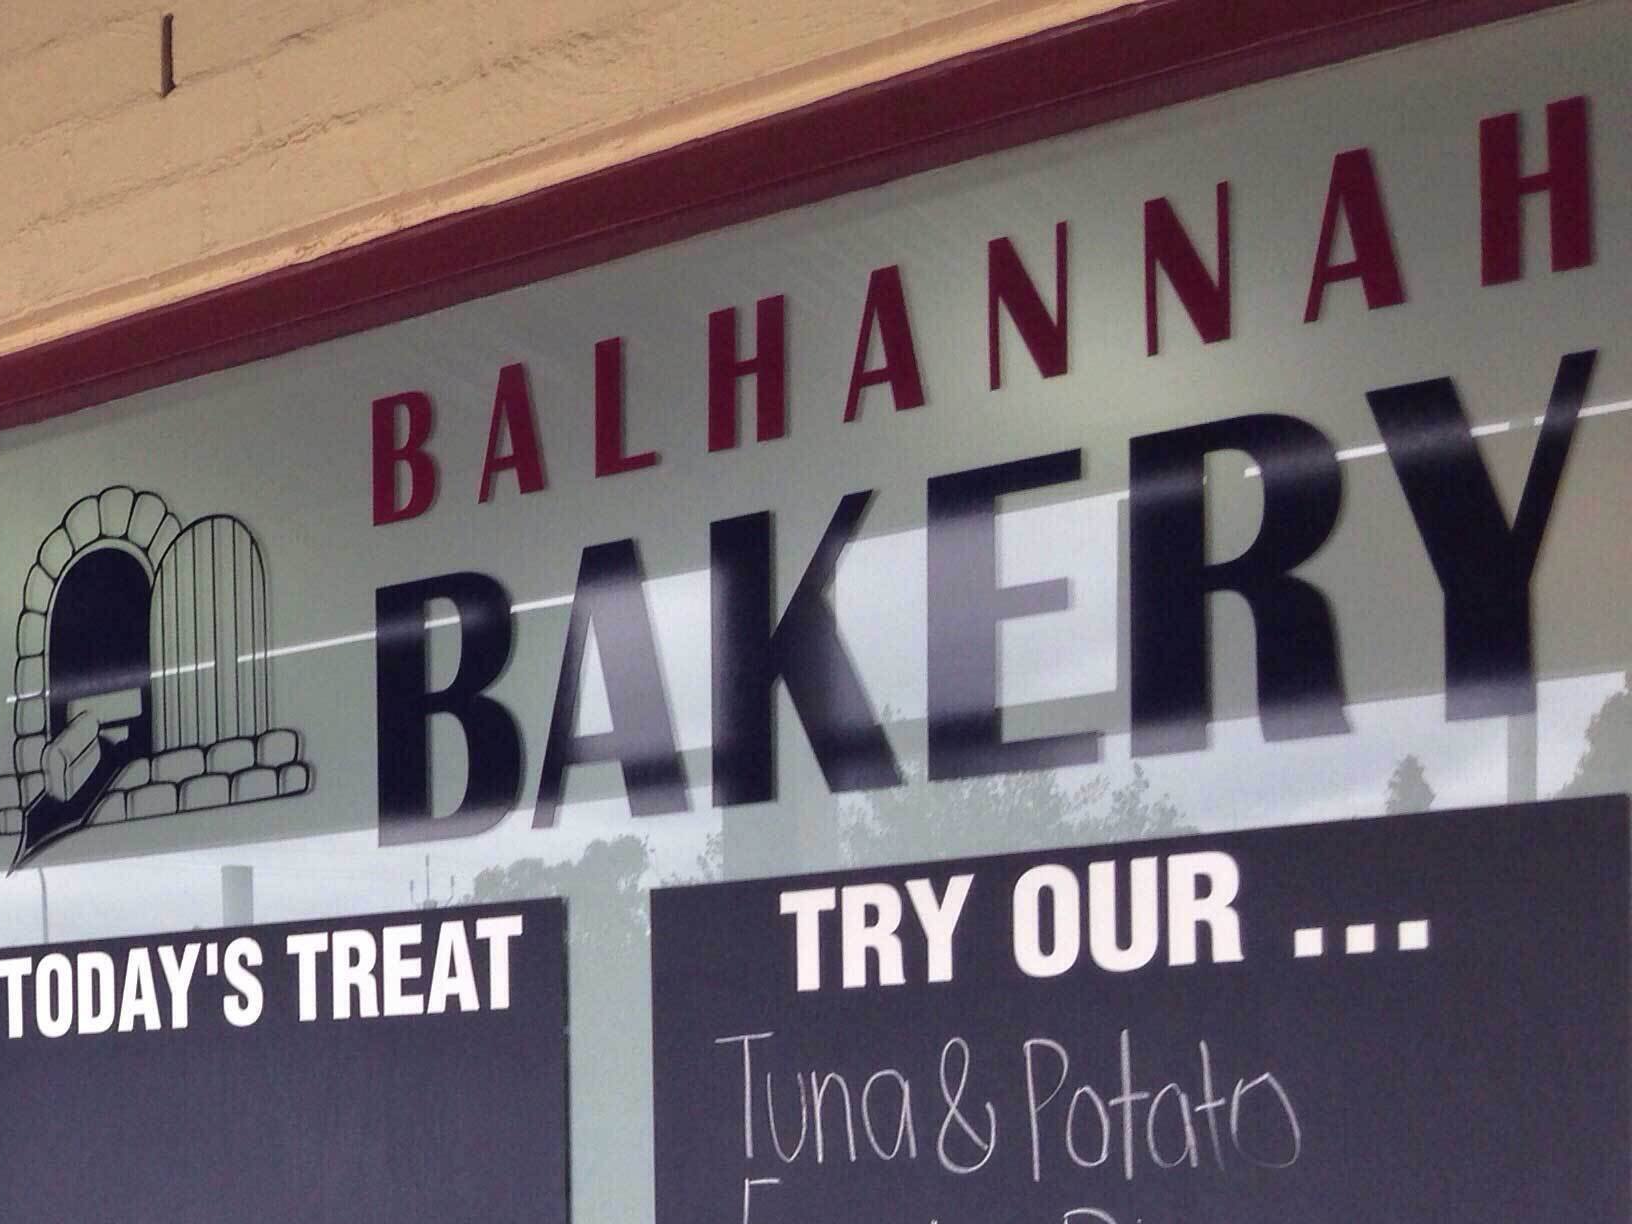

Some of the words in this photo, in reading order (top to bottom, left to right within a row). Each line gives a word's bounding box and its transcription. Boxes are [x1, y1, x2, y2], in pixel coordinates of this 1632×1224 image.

[371, 95, 1595, 527] BALHANNAH
[374, 349, 1599, 848] BAKERY
[287, 915, 524, 1022] TREAT
[779, 873, 975, 993] TRY
[1012, 850, 1244, 979] OUR
[715, 1031, 917, 1164] Tuna
[1023, 1028, 1303, 1182] Potato
